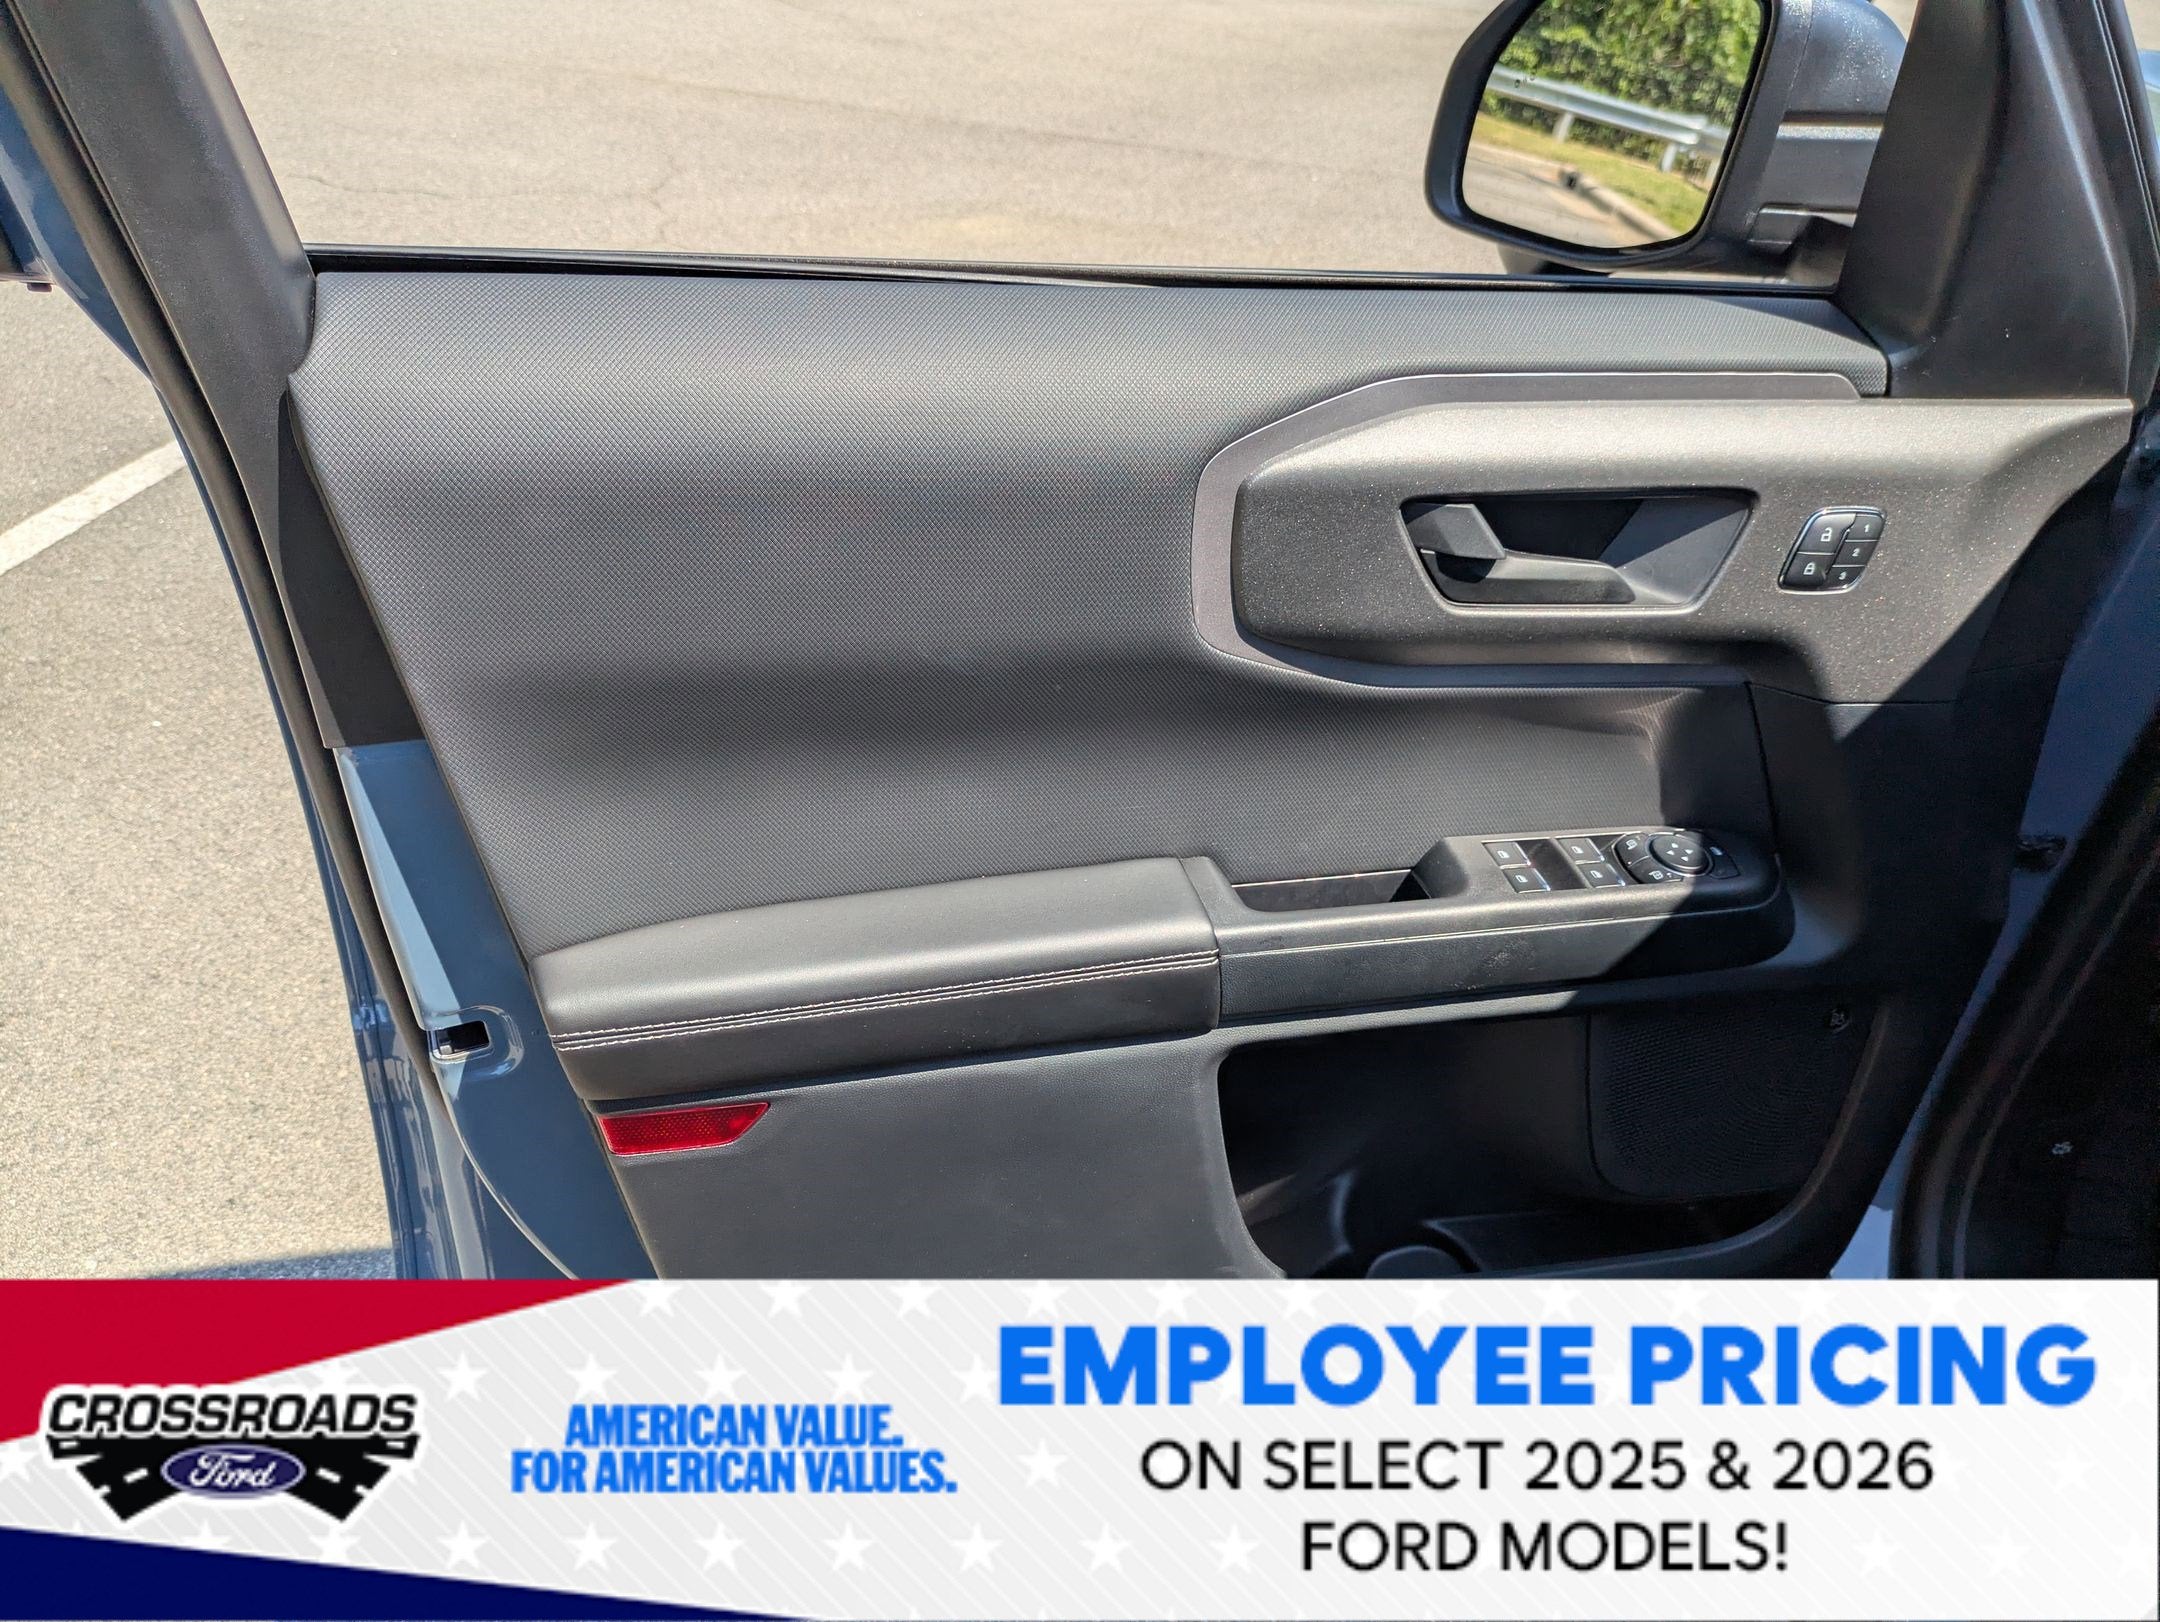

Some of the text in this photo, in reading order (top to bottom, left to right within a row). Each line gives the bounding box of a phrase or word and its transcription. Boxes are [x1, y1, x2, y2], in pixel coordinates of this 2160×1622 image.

[1863, 524, 1870, 533] 1
[1852, 548, 1860, 557] 2
[1838, 572, 1847, 580] 3
